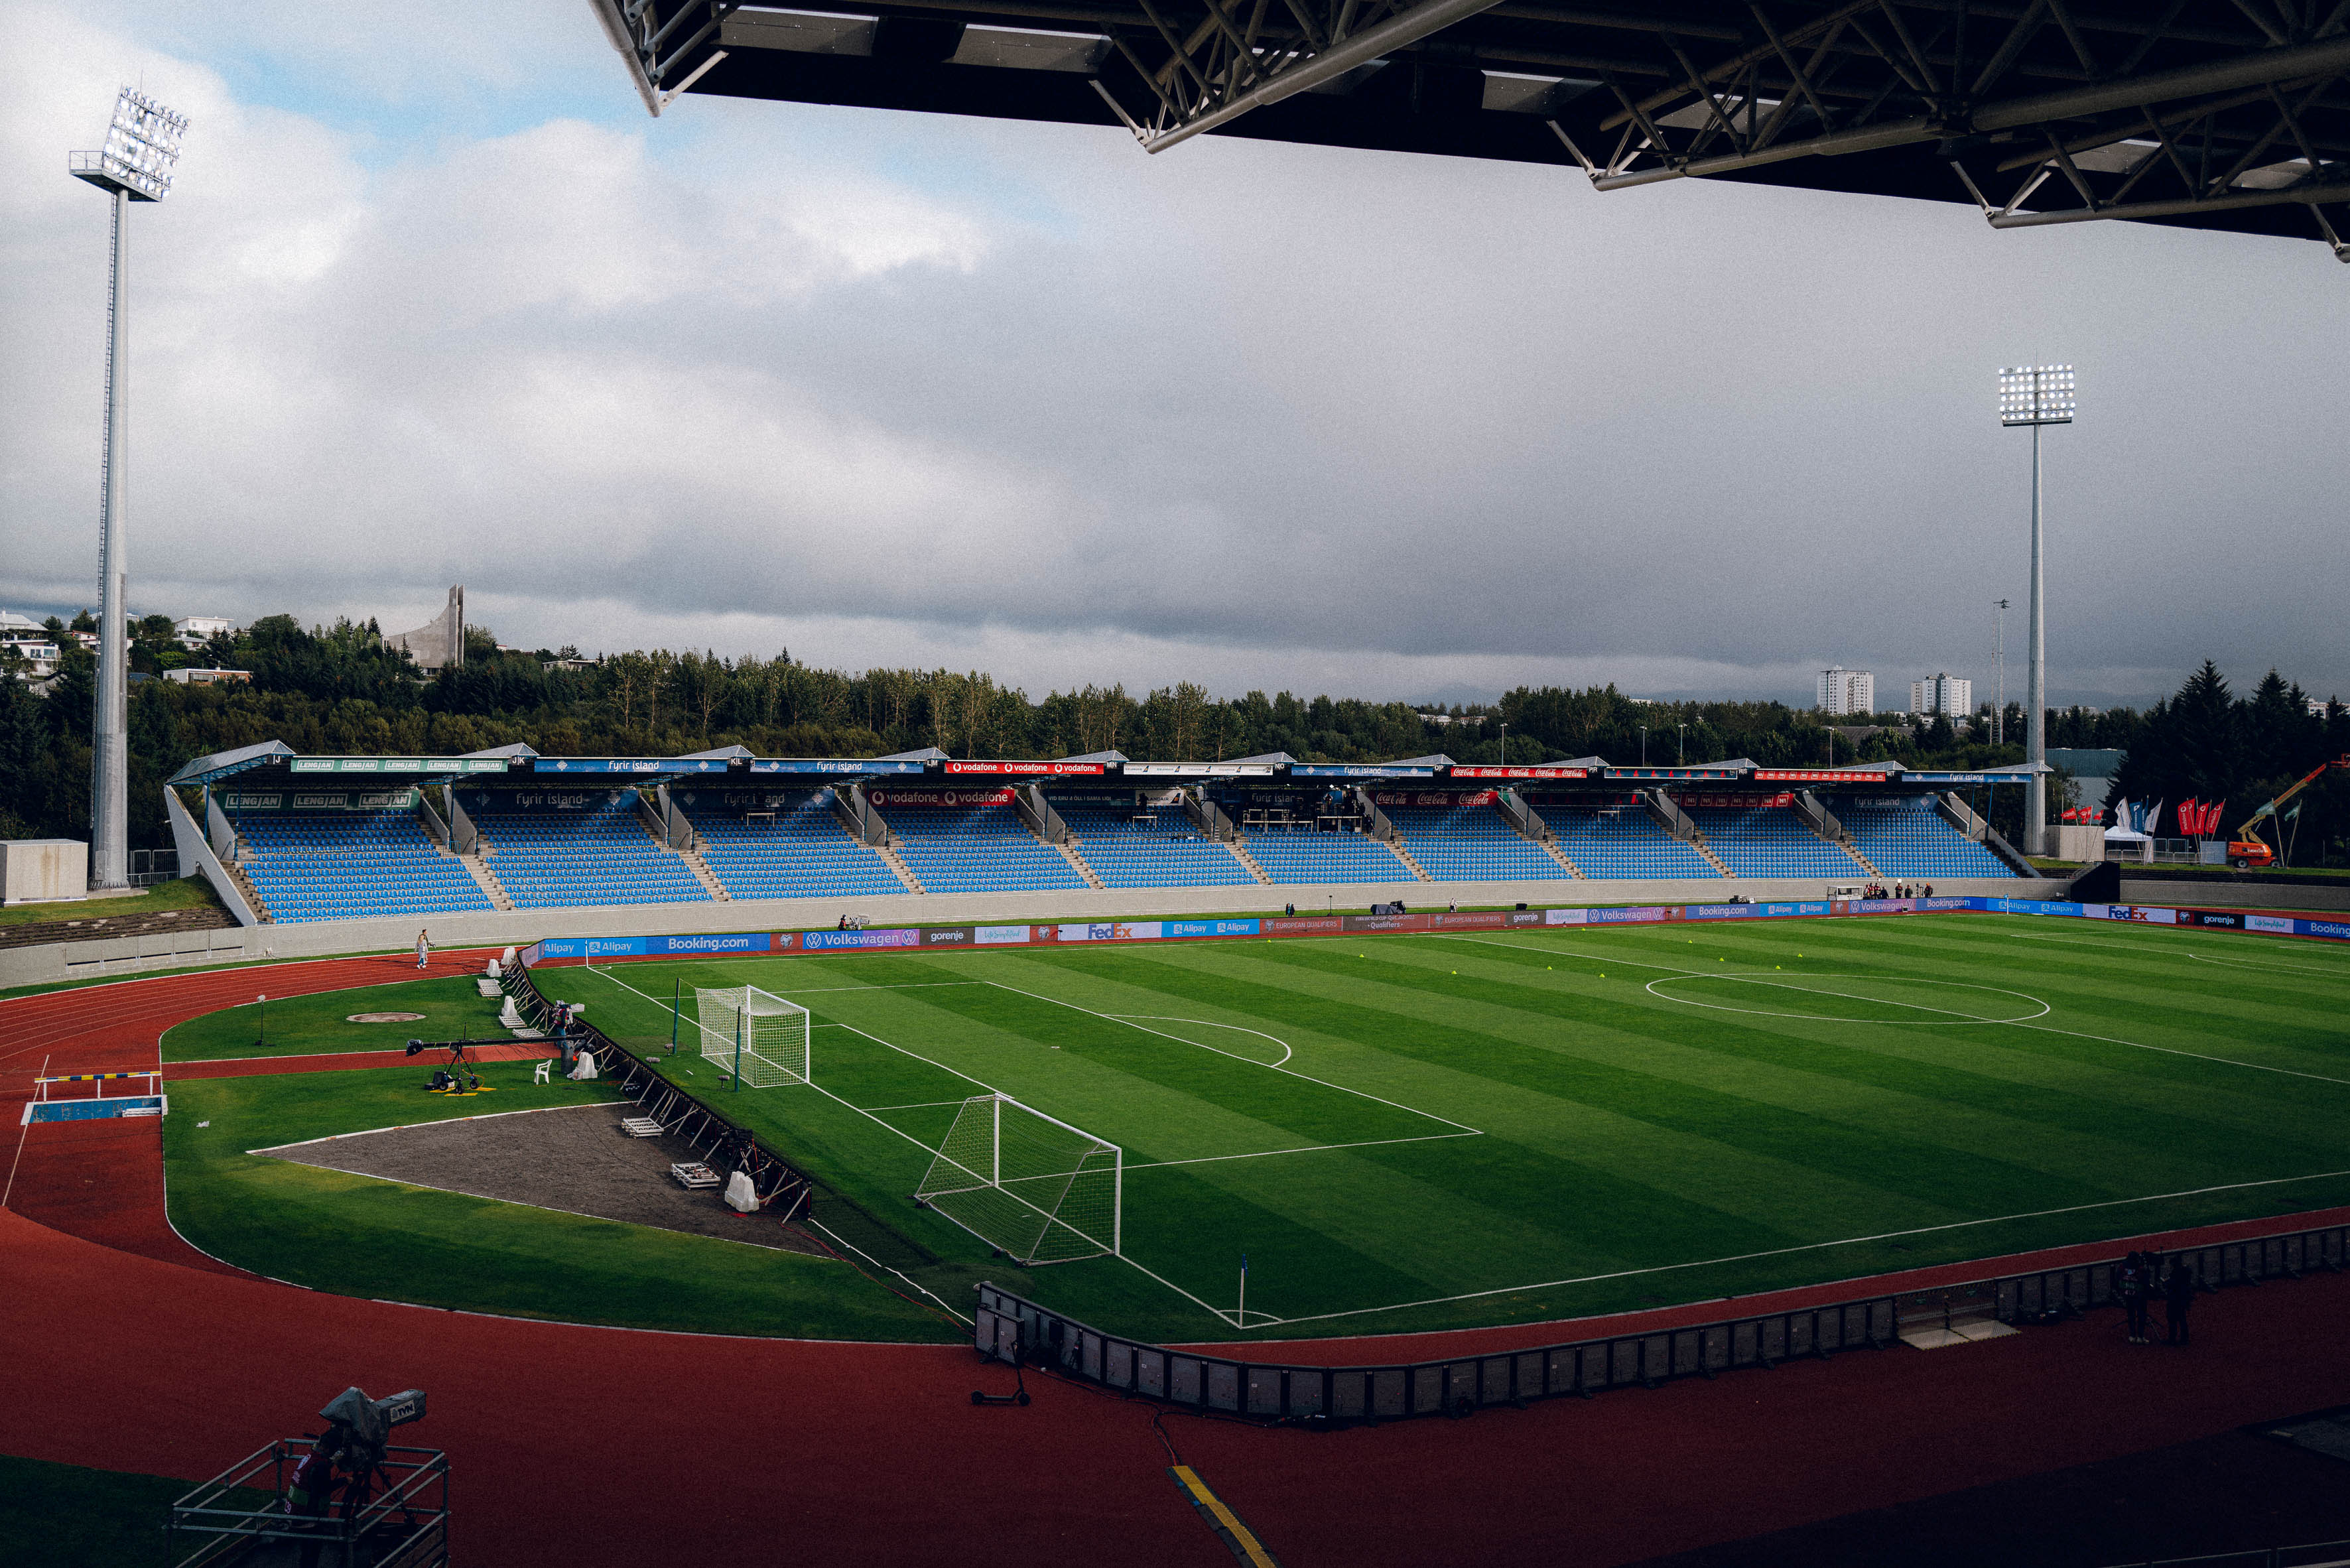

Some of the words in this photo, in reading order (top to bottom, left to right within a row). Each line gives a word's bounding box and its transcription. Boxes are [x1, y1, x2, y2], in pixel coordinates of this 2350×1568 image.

[609, 760, 630, 771] fyrir
[816, 761, 836, 772] fyrir
[1344, 766, 1362, 775] fyrir
[516, 793, 544, 807] fyrir
[724, 793, 749, 807] fyrir
[887, 791, 938, 803] vodafone
[958, 791, 1008, 803] vodafone
[1855, 796, 1873, 807] fyrir
[1861, 901, 1903, 911] Volkswagen
[1927, 898, 1970, 909] Booking.com
[2008, 902, 2030, 911] Alipay
[2051, 905, 2073, 913] Alipay
[1601, 910, 1652, 920] Volkswagen
[1699, 906, 1747, 917] Booking.com
[2108, 905, 2148, 921] FedEx
[1513, 913, 1538, 922] gorenje
[2203, 915, 2235, 925] gorenje
[1088, 923, 1132, 939] FedEx
[1183, 924, 1207, 933] Alipay
[1226, 923, 1250, 932] Alipay
[824, 933, 899, 946] Volkswagen
[931, 930, 964, 941] gorenje
[545, 943, 574, 953] Alipay
[602, 942, 631, 952] Alipay
[668, 937, 749, 950] Booking.com
[397, 1404, 413, 1416] TVN
